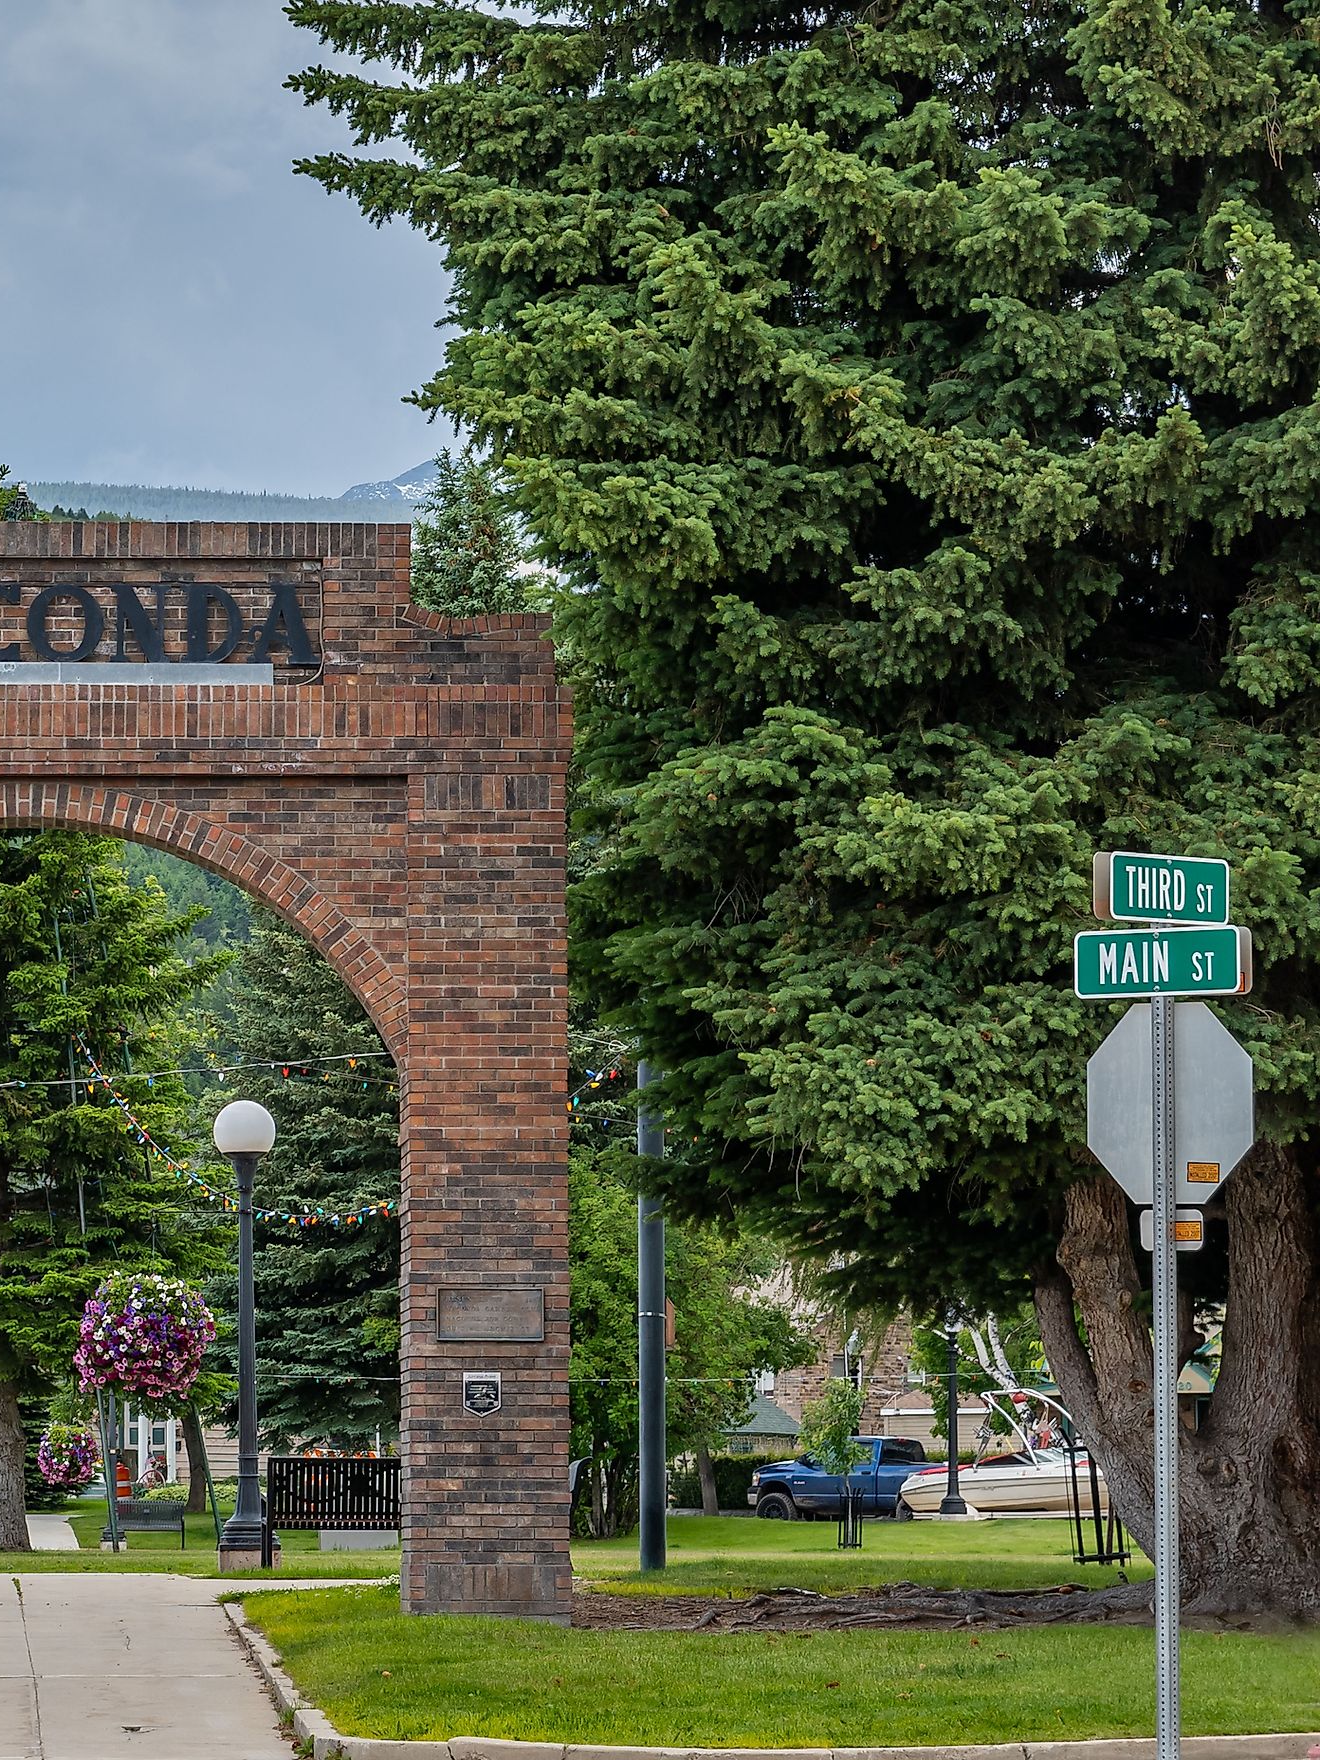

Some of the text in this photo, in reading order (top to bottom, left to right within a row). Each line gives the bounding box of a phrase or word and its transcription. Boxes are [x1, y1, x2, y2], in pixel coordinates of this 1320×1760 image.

[1125, 865, 1214, 913] THIRD ST
[1098, 940, 1215, 985] MAIN ST
